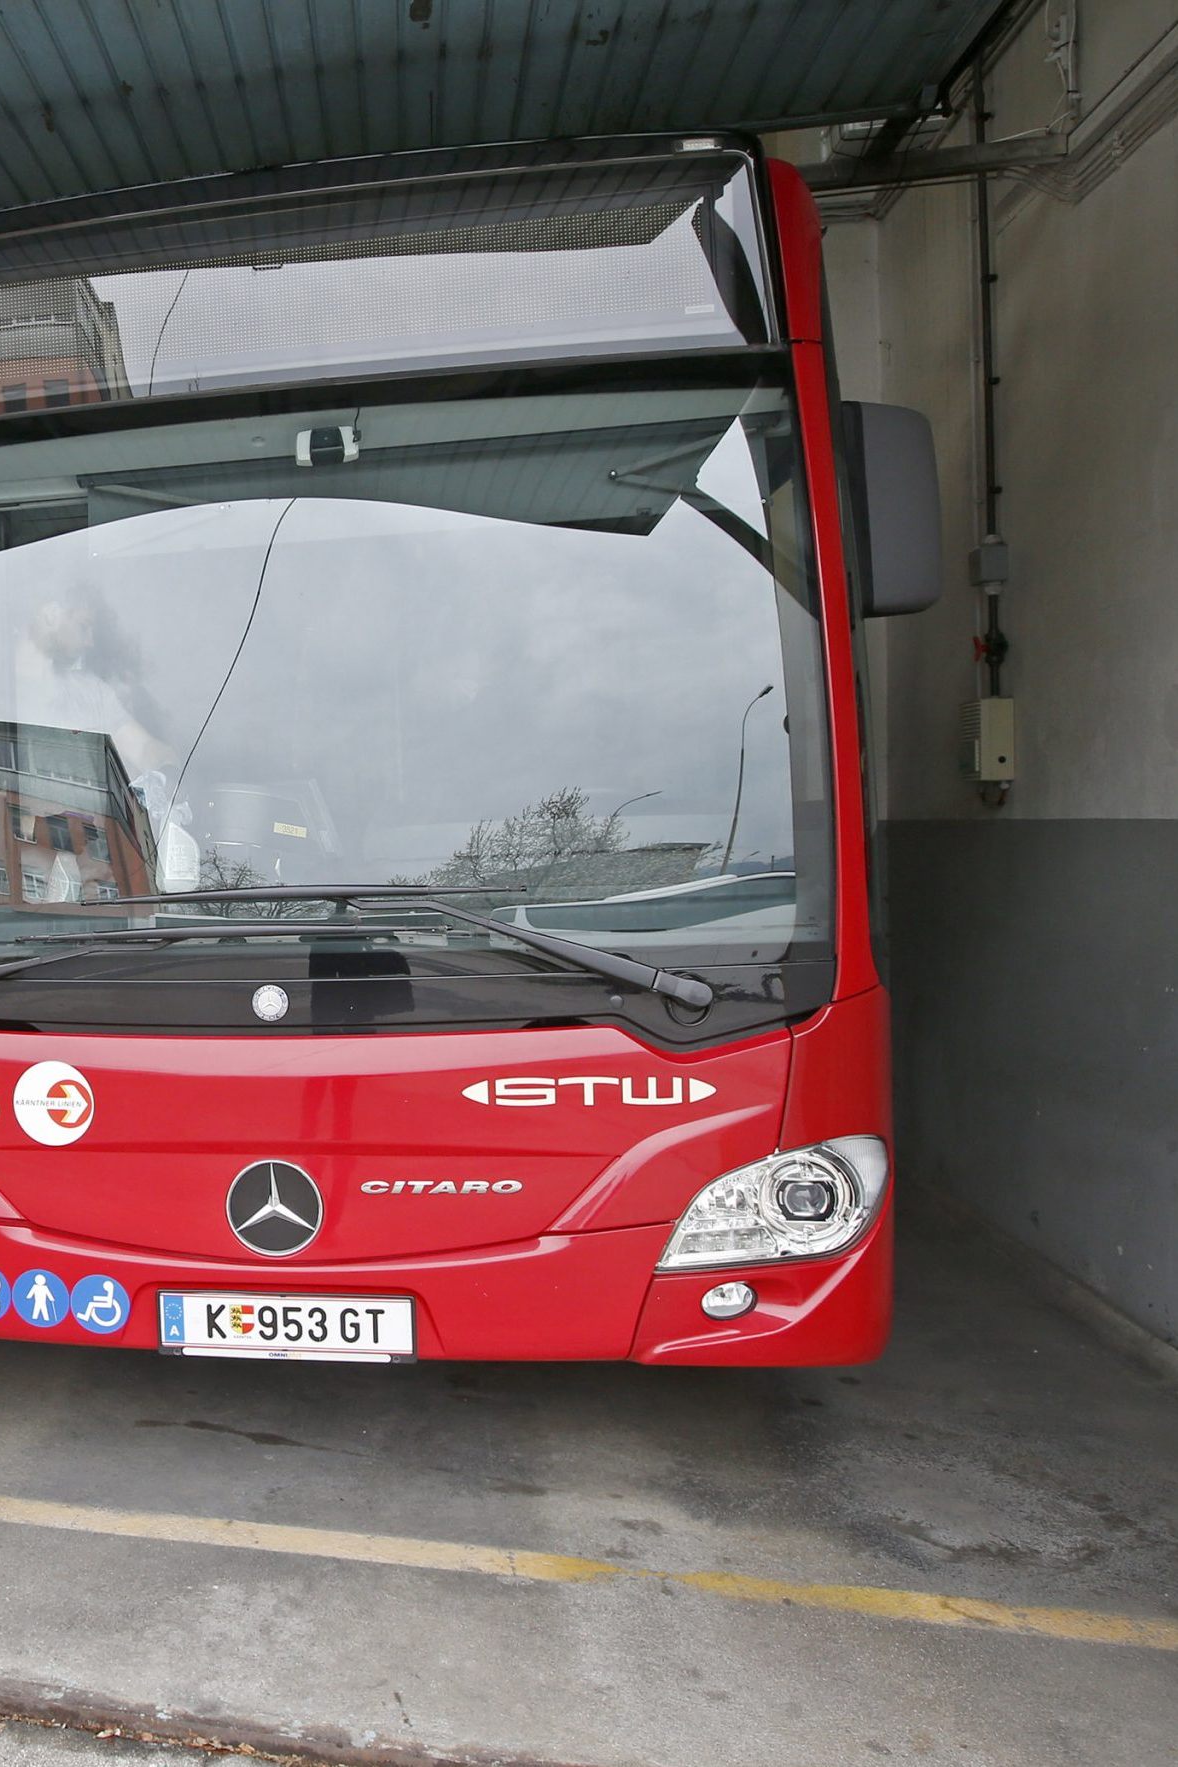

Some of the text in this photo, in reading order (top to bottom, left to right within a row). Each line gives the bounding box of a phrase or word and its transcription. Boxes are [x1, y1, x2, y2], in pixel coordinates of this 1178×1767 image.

[494, 1076, 684, 1106] STW
[15, 1099, 82, 1108] KÄRNTNER LINIEN
[360, 1179, 524, 1195] CITARO
[170, 1325, 180, 1337] A
[206, 1303, 385, 1344] K 953 GT
